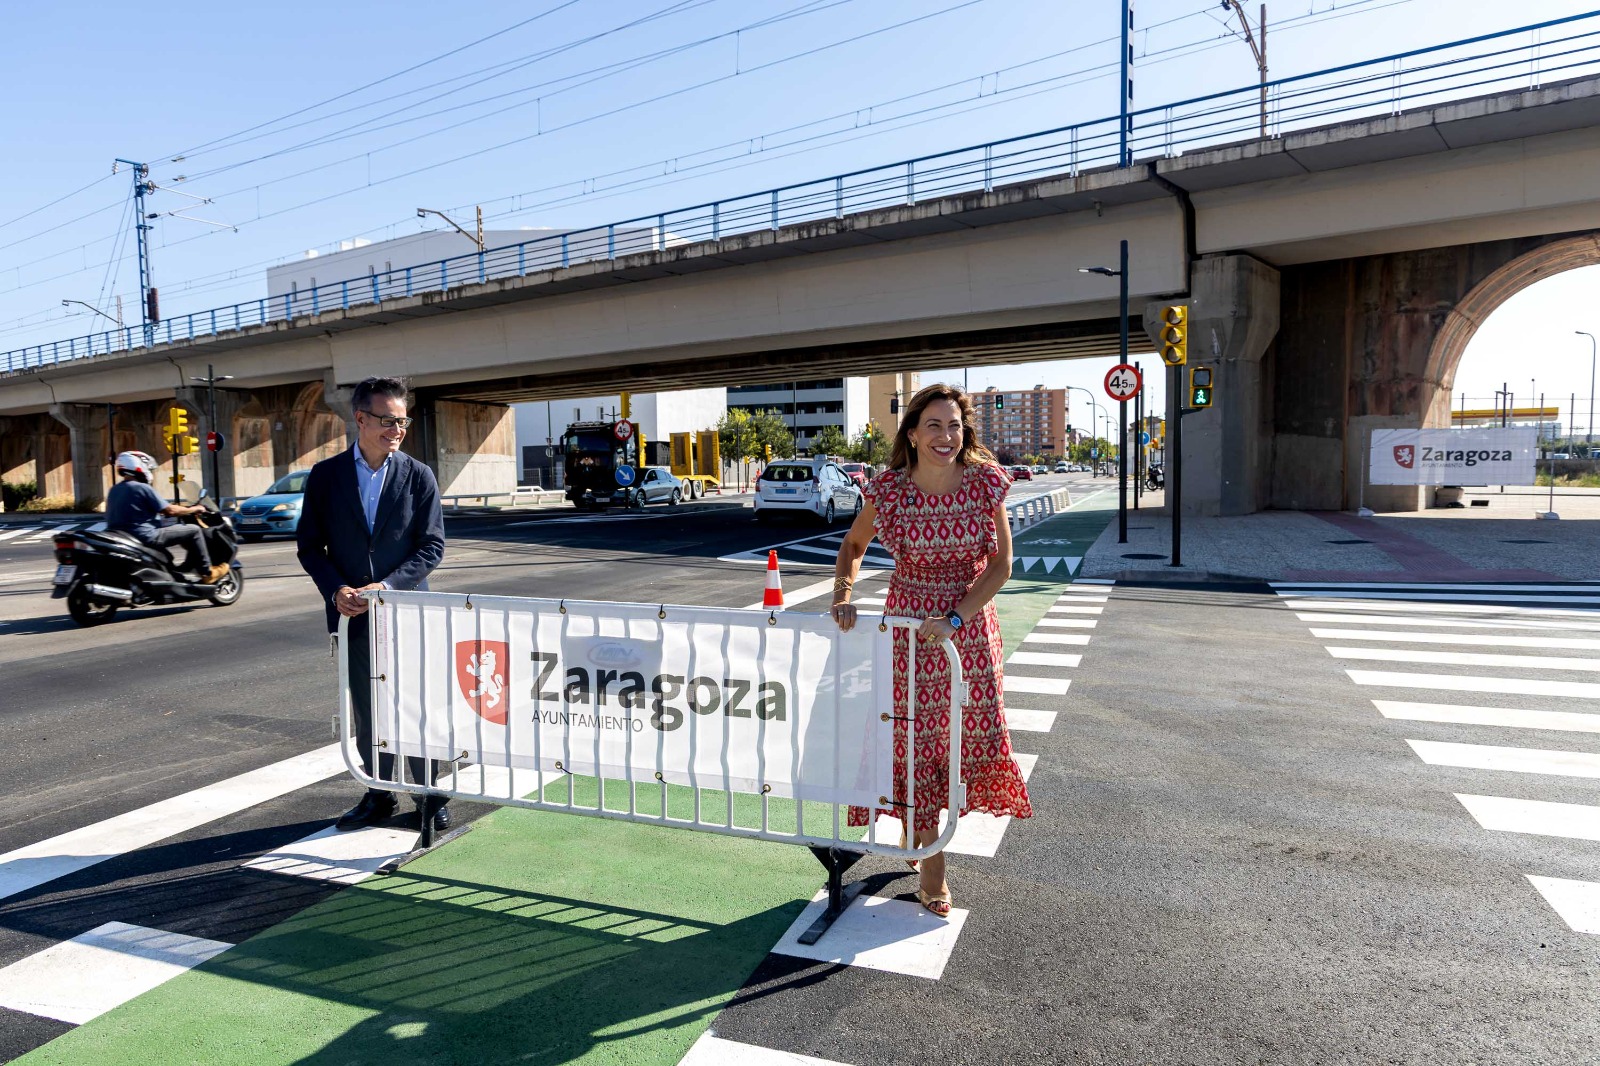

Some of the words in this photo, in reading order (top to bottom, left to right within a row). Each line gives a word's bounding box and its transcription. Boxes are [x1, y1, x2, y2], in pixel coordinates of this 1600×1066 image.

[1421, 447, 1512, 466] Zaragoza
[530, 651, 787, 731] Zaragoza
[531, 710, 644, 732] AYUNTAMIENTO
